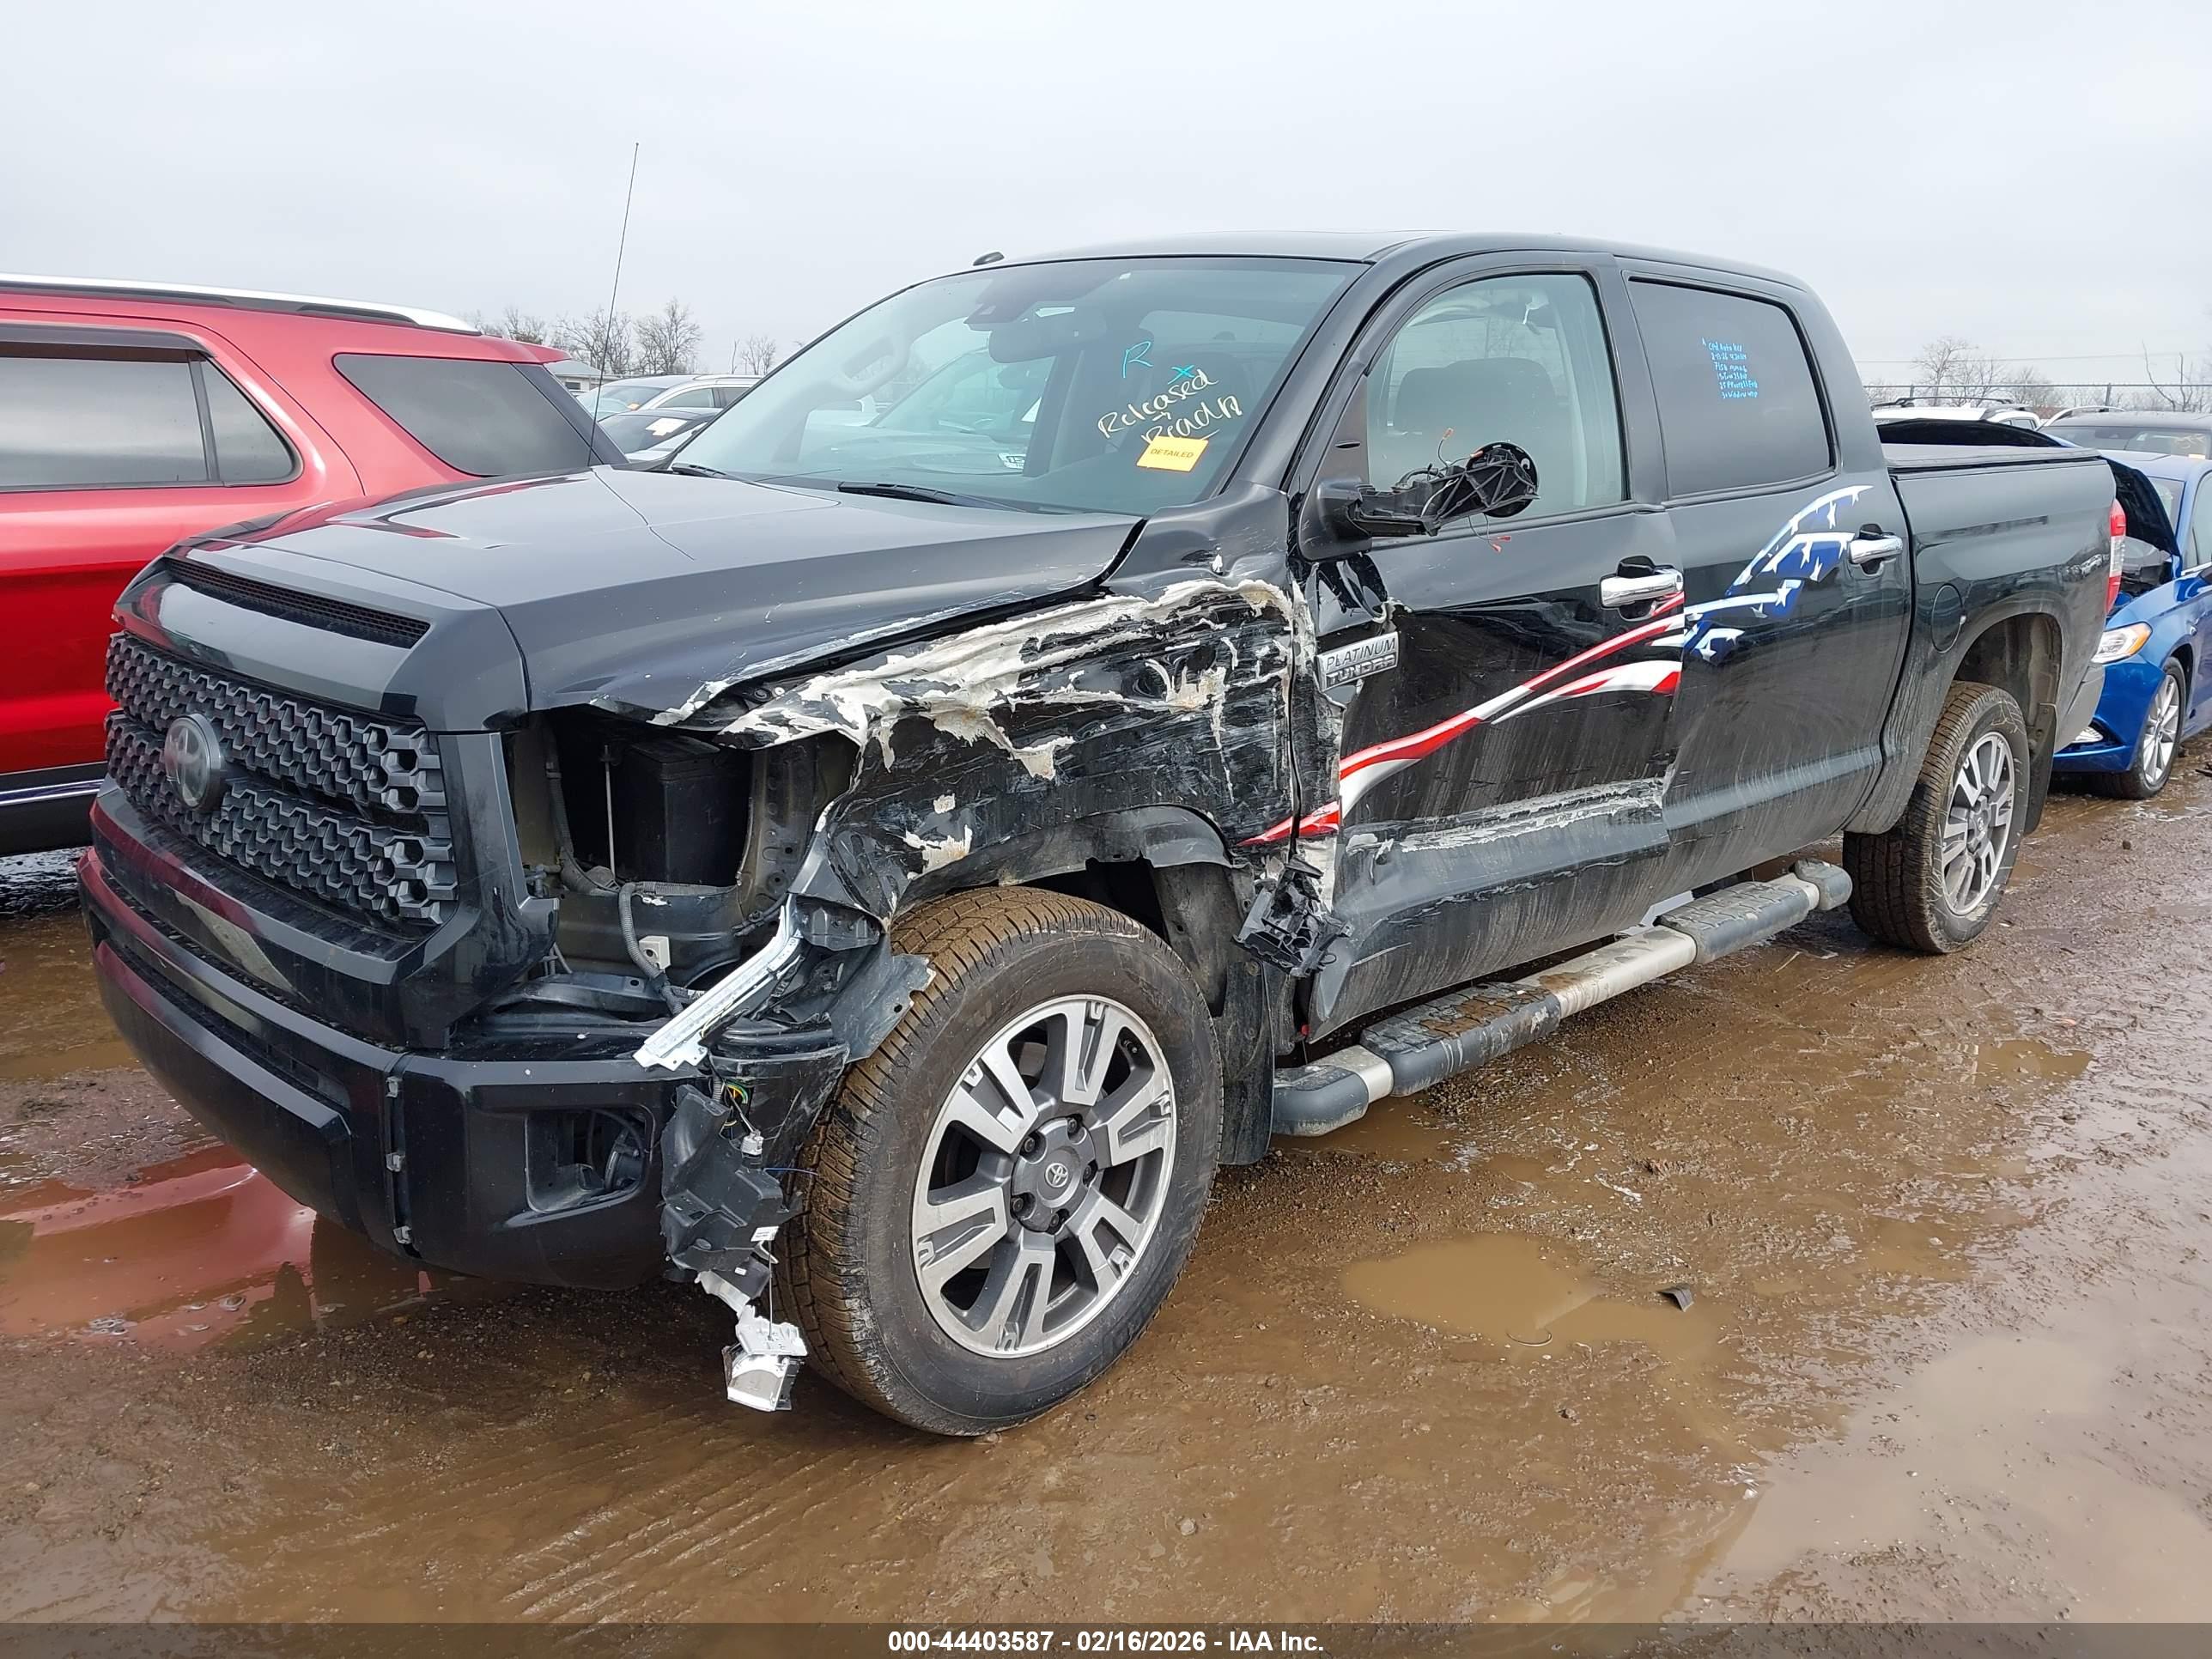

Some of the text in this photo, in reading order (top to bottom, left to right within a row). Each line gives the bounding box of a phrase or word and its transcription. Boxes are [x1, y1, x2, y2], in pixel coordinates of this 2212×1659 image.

[1122, 340, 1154, 379] R
[1097, 368, 1219, 439] Released
[1150, 447, 1194, 459] DETAILED
[1326, 653, 1396, 686] TUNDRA
[1327, 637, 1395, 671] PLATINUM
